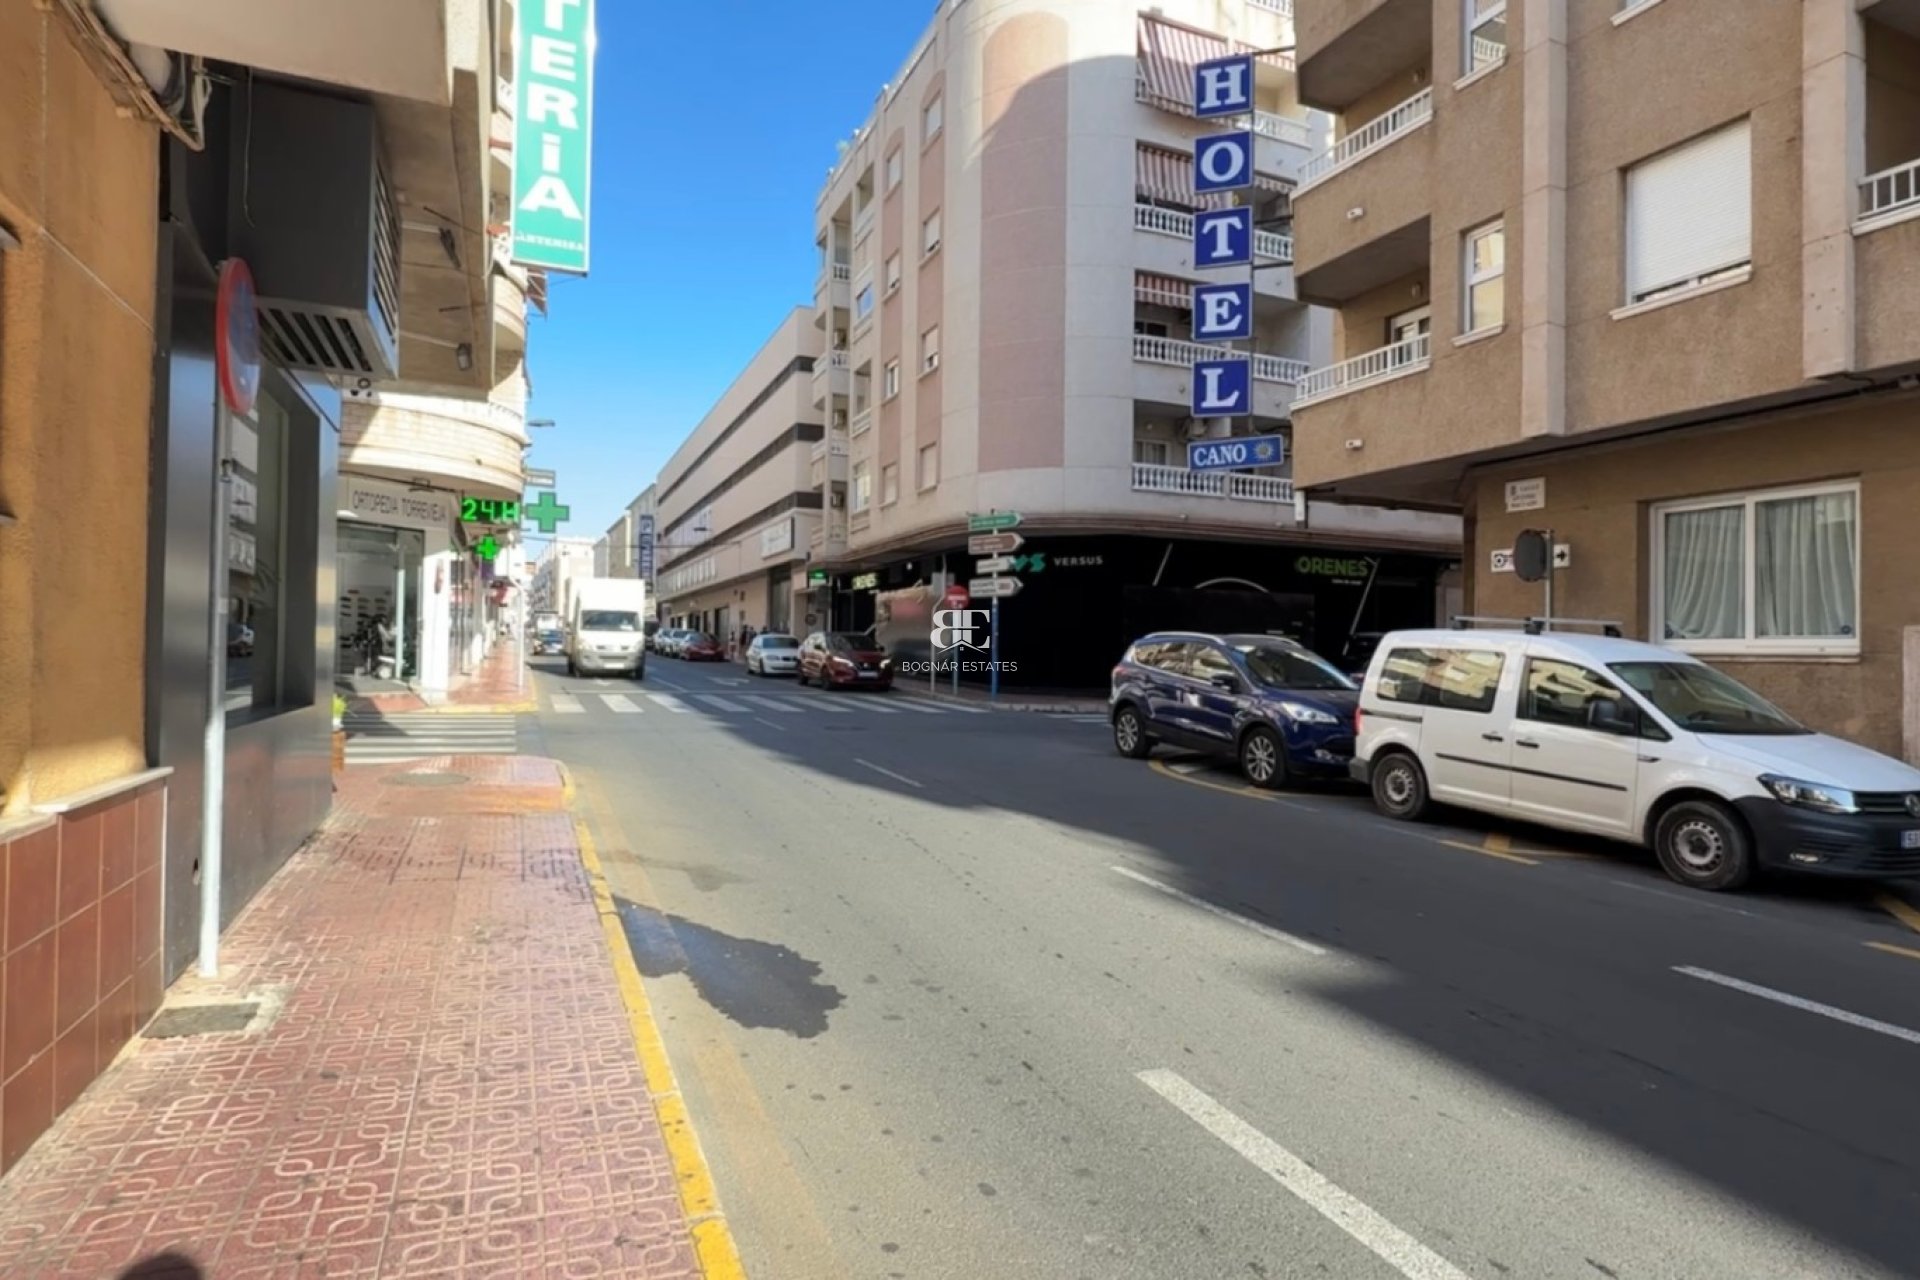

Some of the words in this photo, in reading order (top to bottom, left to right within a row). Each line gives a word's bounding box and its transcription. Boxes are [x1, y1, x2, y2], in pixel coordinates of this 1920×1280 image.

[1200, 64, 1246, 408] HOTEL
[1193, 443, 1247, 466] CANO
[353, 489, 398, 514] ORTOPEDIA
[1053, 555, 1104, 567] VERSUS
[1298, 556, 1369, 576] ORENES
